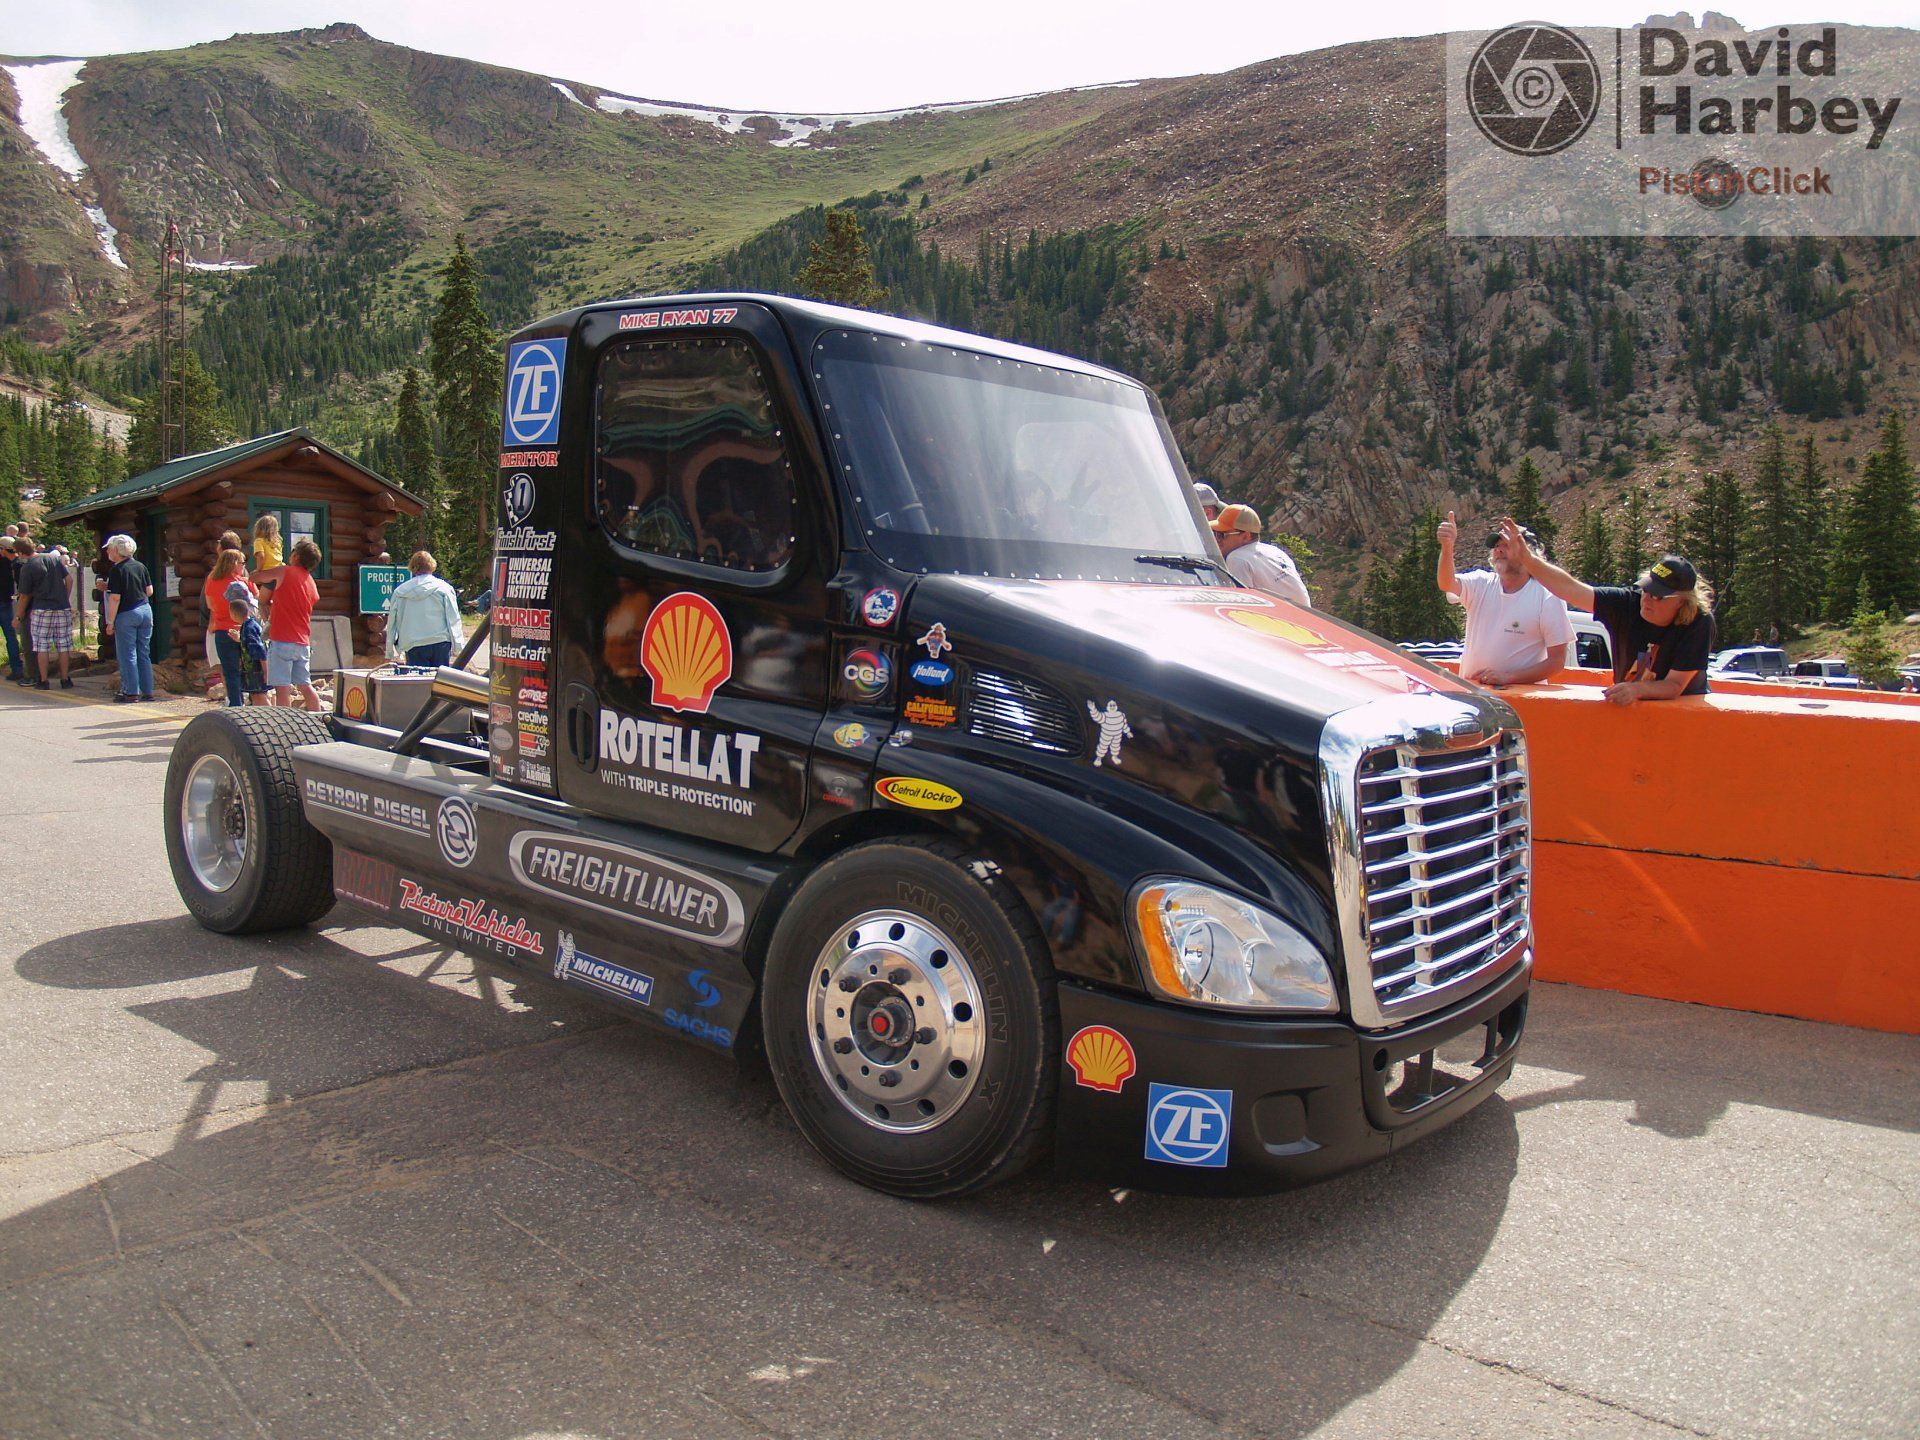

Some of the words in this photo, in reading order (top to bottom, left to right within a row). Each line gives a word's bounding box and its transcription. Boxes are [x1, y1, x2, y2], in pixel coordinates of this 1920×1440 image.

[619, 312, 660, 330] MIKE
[662, 309, 710, 327] RYAN
[712, 308, 738, 324] 77
[512, 364, 557, 422] ZF
[500, 451, 559, 468] MERITOR
[509, 558, 552, 571] UNIVERSAL
[381, 585, 393, 594] ON
[508, 571, 550, 586] TECHNICAL
[506, 585, 548, 599] INSTITUTE
[492, 606, 551, 629] ACCURIDE
[492, 642, 547, 662] MasterCraft
[844, 664, 890, 685] CGS
[913, 663, 950, 682] Holland
[517, 710, 548, 725] creative
[517, 720, 548, 734] handbook
[600, 708, 732, 786] ROTELLA
[735, 732, 760, 789] T
[601, 768, 627, 788] WITH
[628, 775, 669, 798] TRIPLE
[672, 784, 753, 817] PROTECTION
[890, 782, 920, 797] Detroit
[922, 785, 957, 805] Locker
[306, 779, 369, 813] DETROIT
[374, 796, 431, 830] DIESEL
[529, 846, 719, 928] FREIGHTLINER
[422, 915, 516, 957] UNLIMITED
[898, 881, 1008, 1043] MICHELIN
[573, 957, 649, 996] MICHELIN
[663, 1008, 733, 1048] SACHS
[1159, 1103, 1221, 1150] ZF
